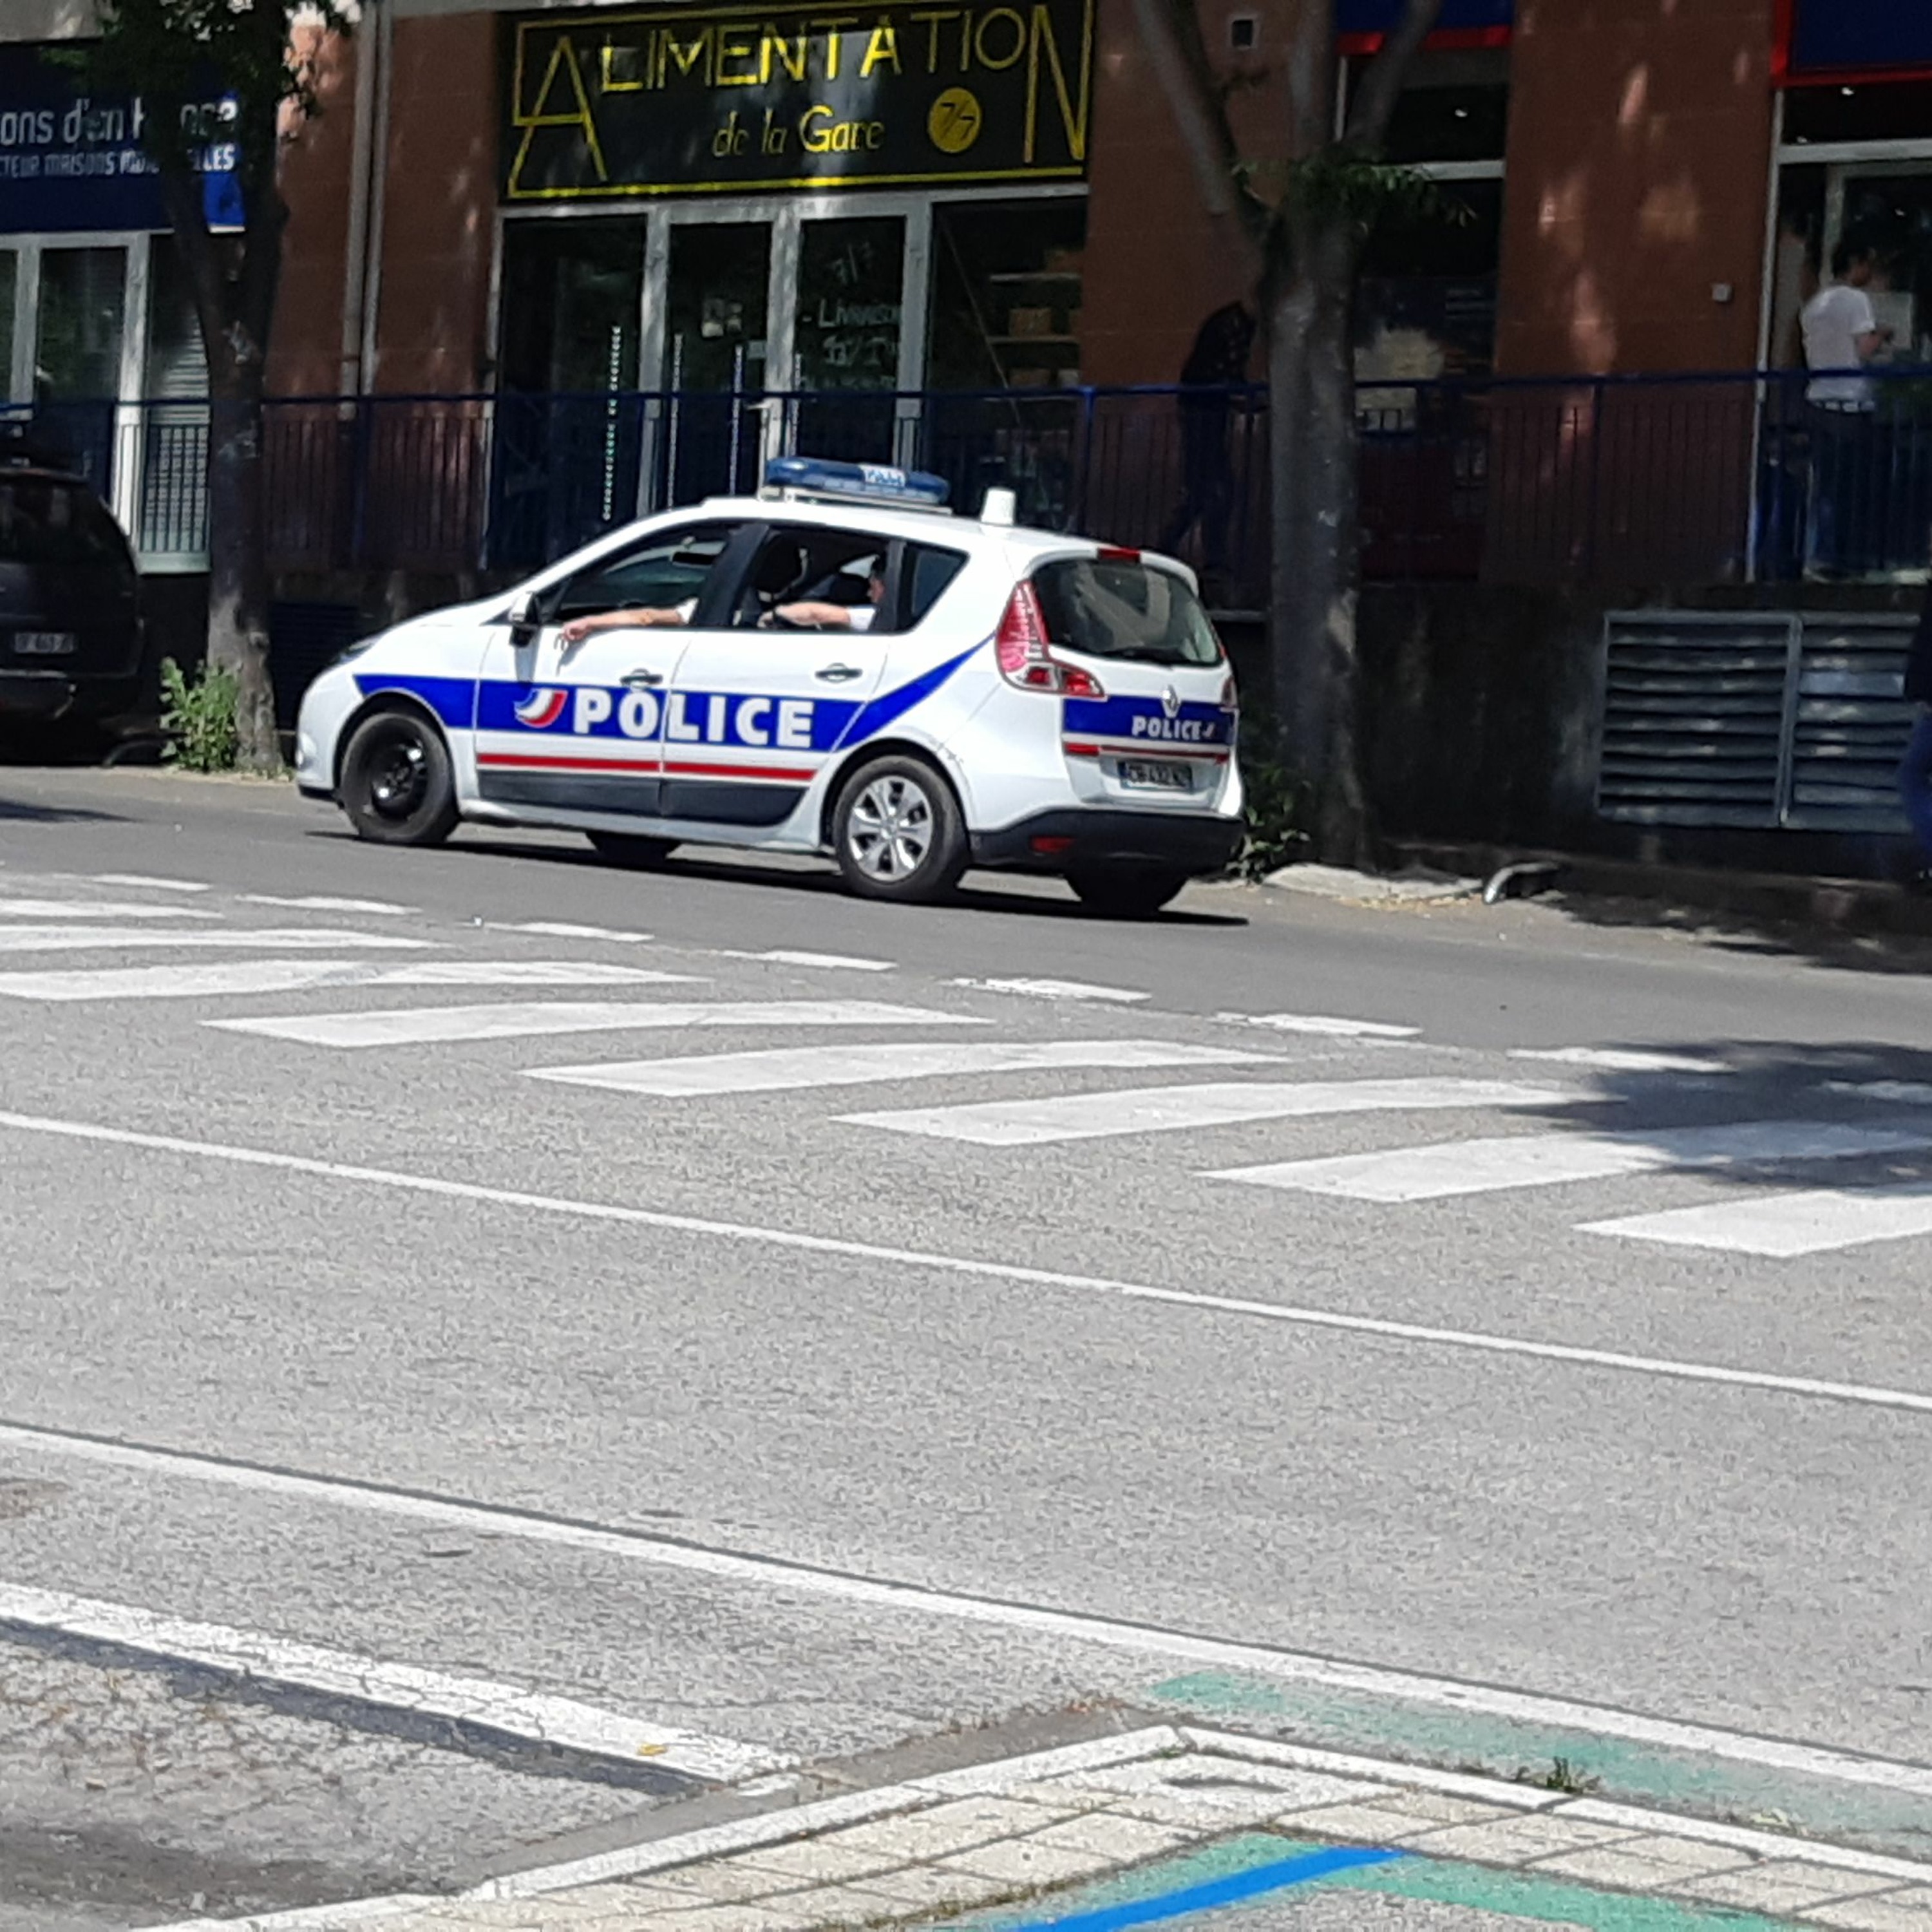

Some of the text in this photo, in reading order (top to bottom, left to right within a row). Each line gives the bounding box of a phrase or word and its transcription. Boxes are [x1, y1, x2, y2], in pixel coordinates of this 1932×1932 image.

[509, 0, 1094, 188] ALIMENTATION
[713, 104, 884, 158] de la Gare
[573, 687, 815, 748] POLICE
[1132, 715, 1202, 740] POLICE
